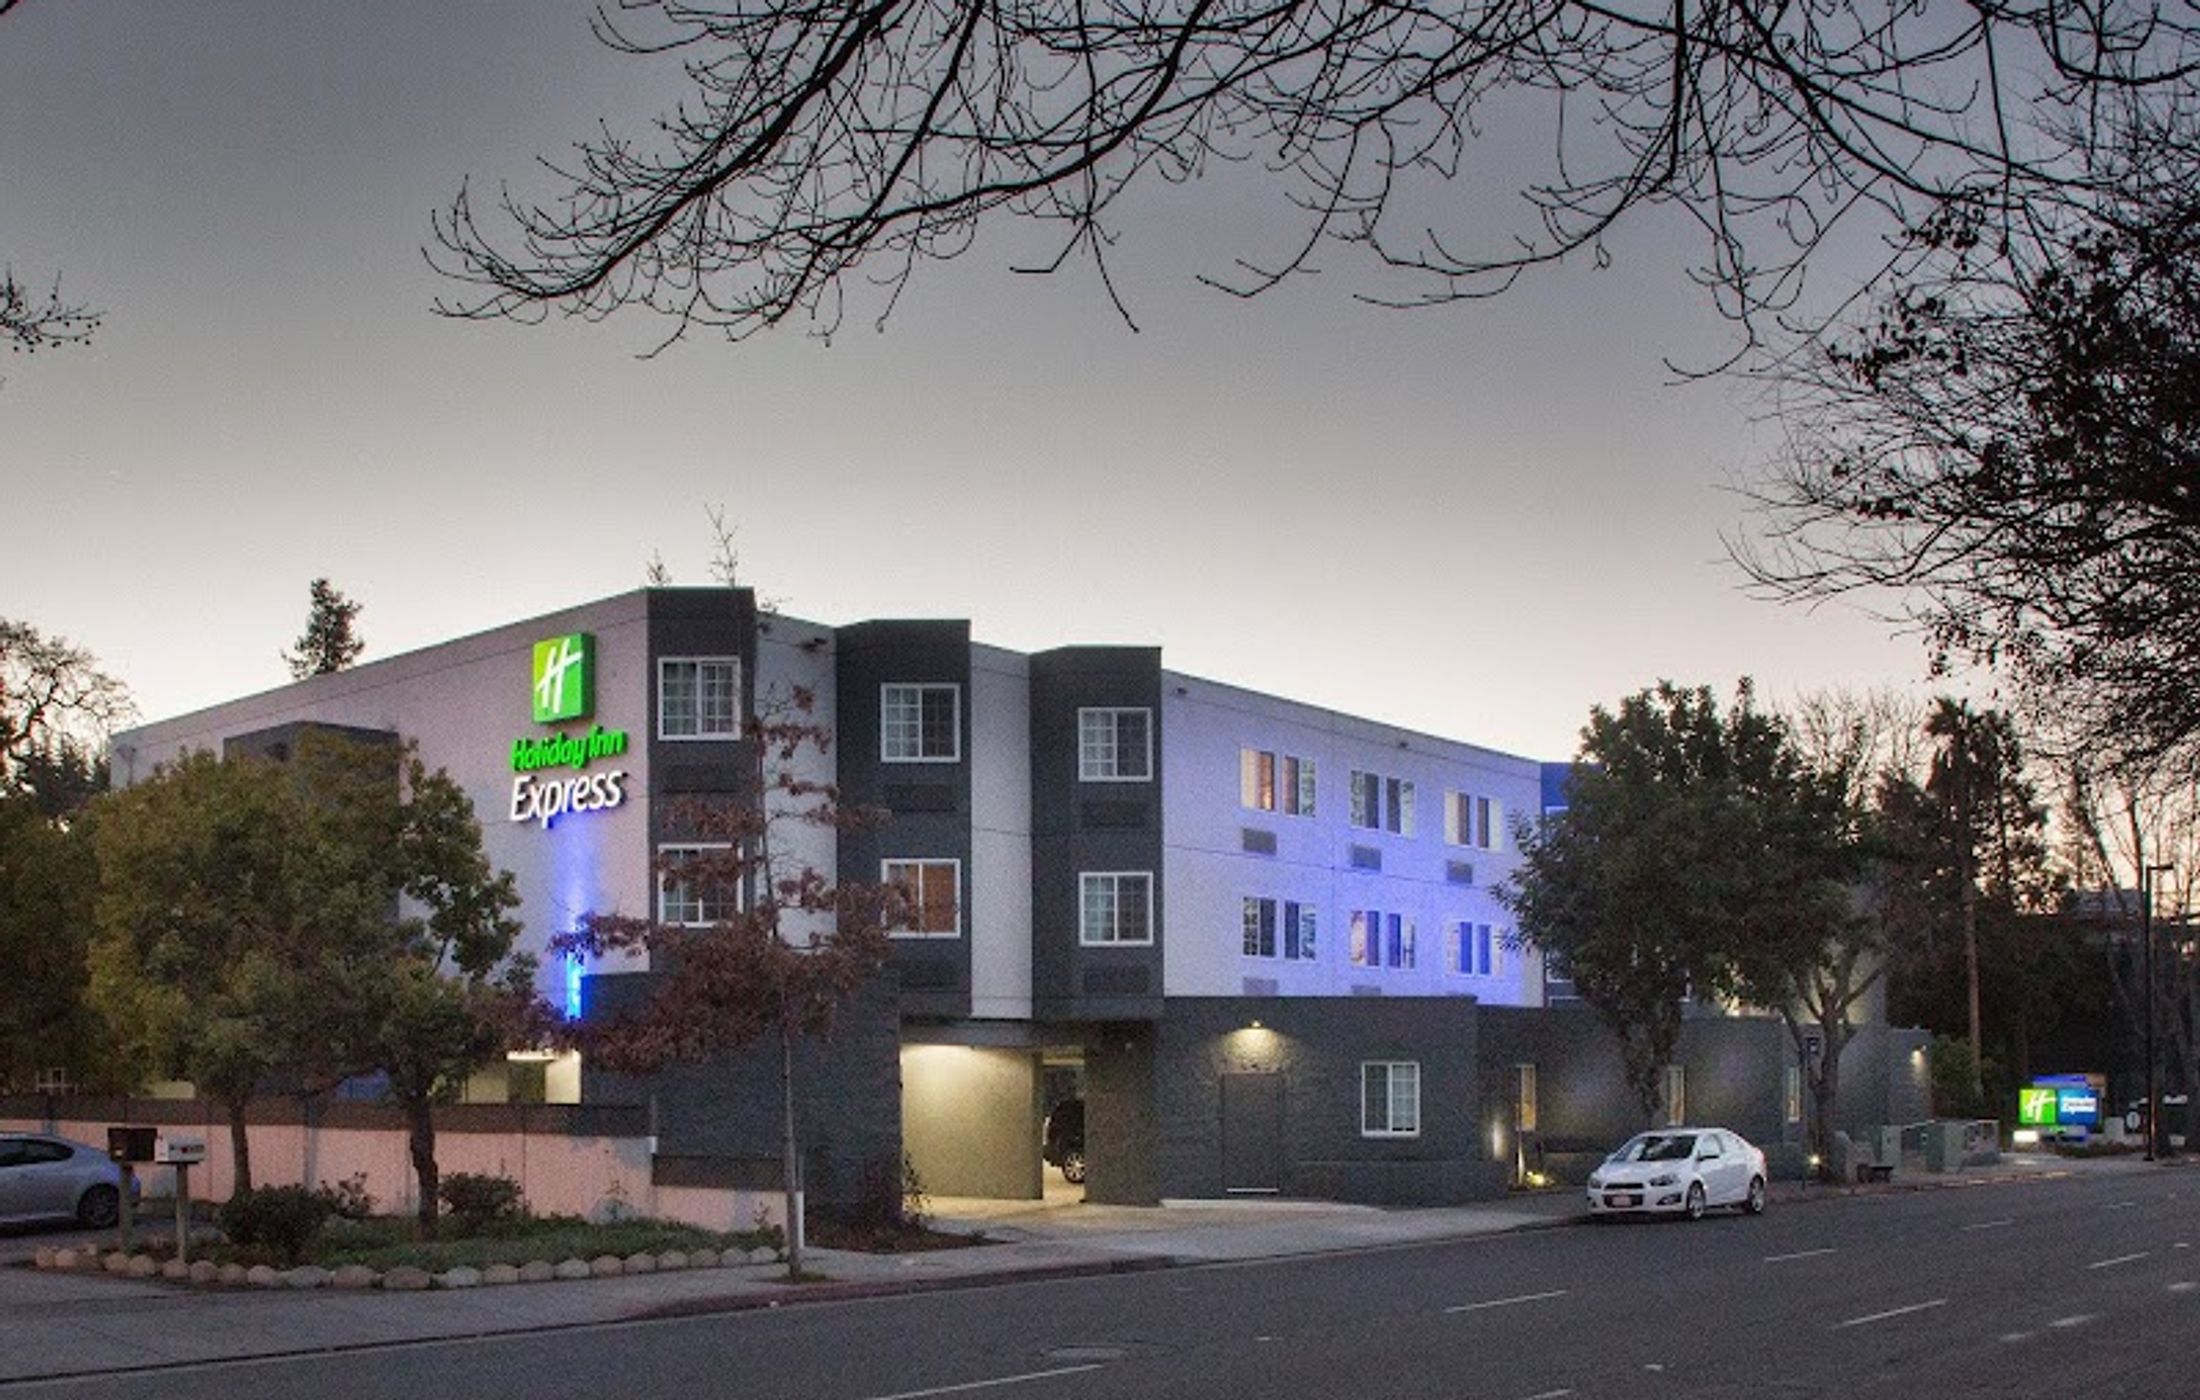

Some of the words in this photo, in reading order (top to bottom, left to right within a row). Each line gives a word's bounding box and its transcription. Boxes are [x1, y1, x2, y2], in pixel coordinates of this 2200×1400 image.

[511, 732, 588, 770] Holiday
[588, 725, 627, 758] Inn
[511, 770, 623, 828] Express
